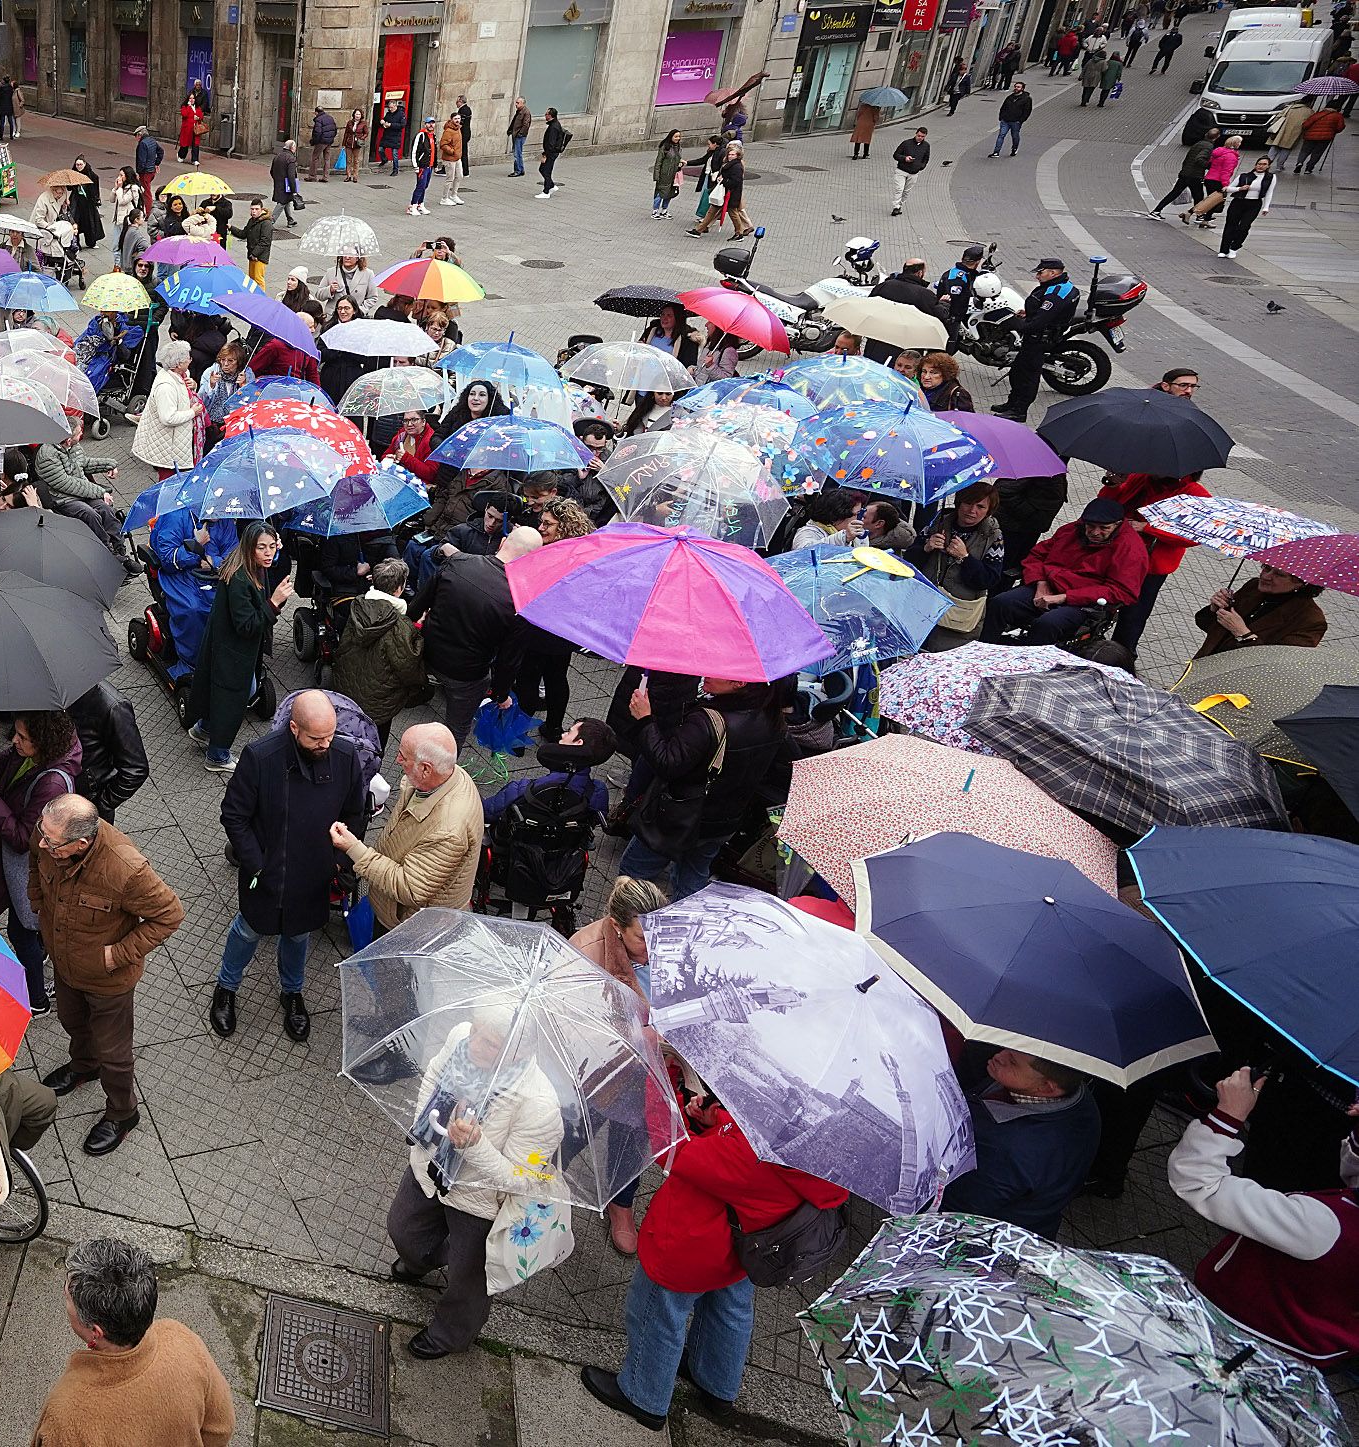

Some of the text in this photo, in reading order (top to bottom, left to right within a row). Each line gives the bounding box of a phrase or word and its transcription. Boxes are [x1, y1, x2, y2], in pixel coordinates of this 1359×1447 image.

[396, 15, 440, 26] Santander
[821, 12, 856, 29] Stromboli
[672, 59, 694, 67] SHOCK
[693, 57, 717, 66] LITERAL
